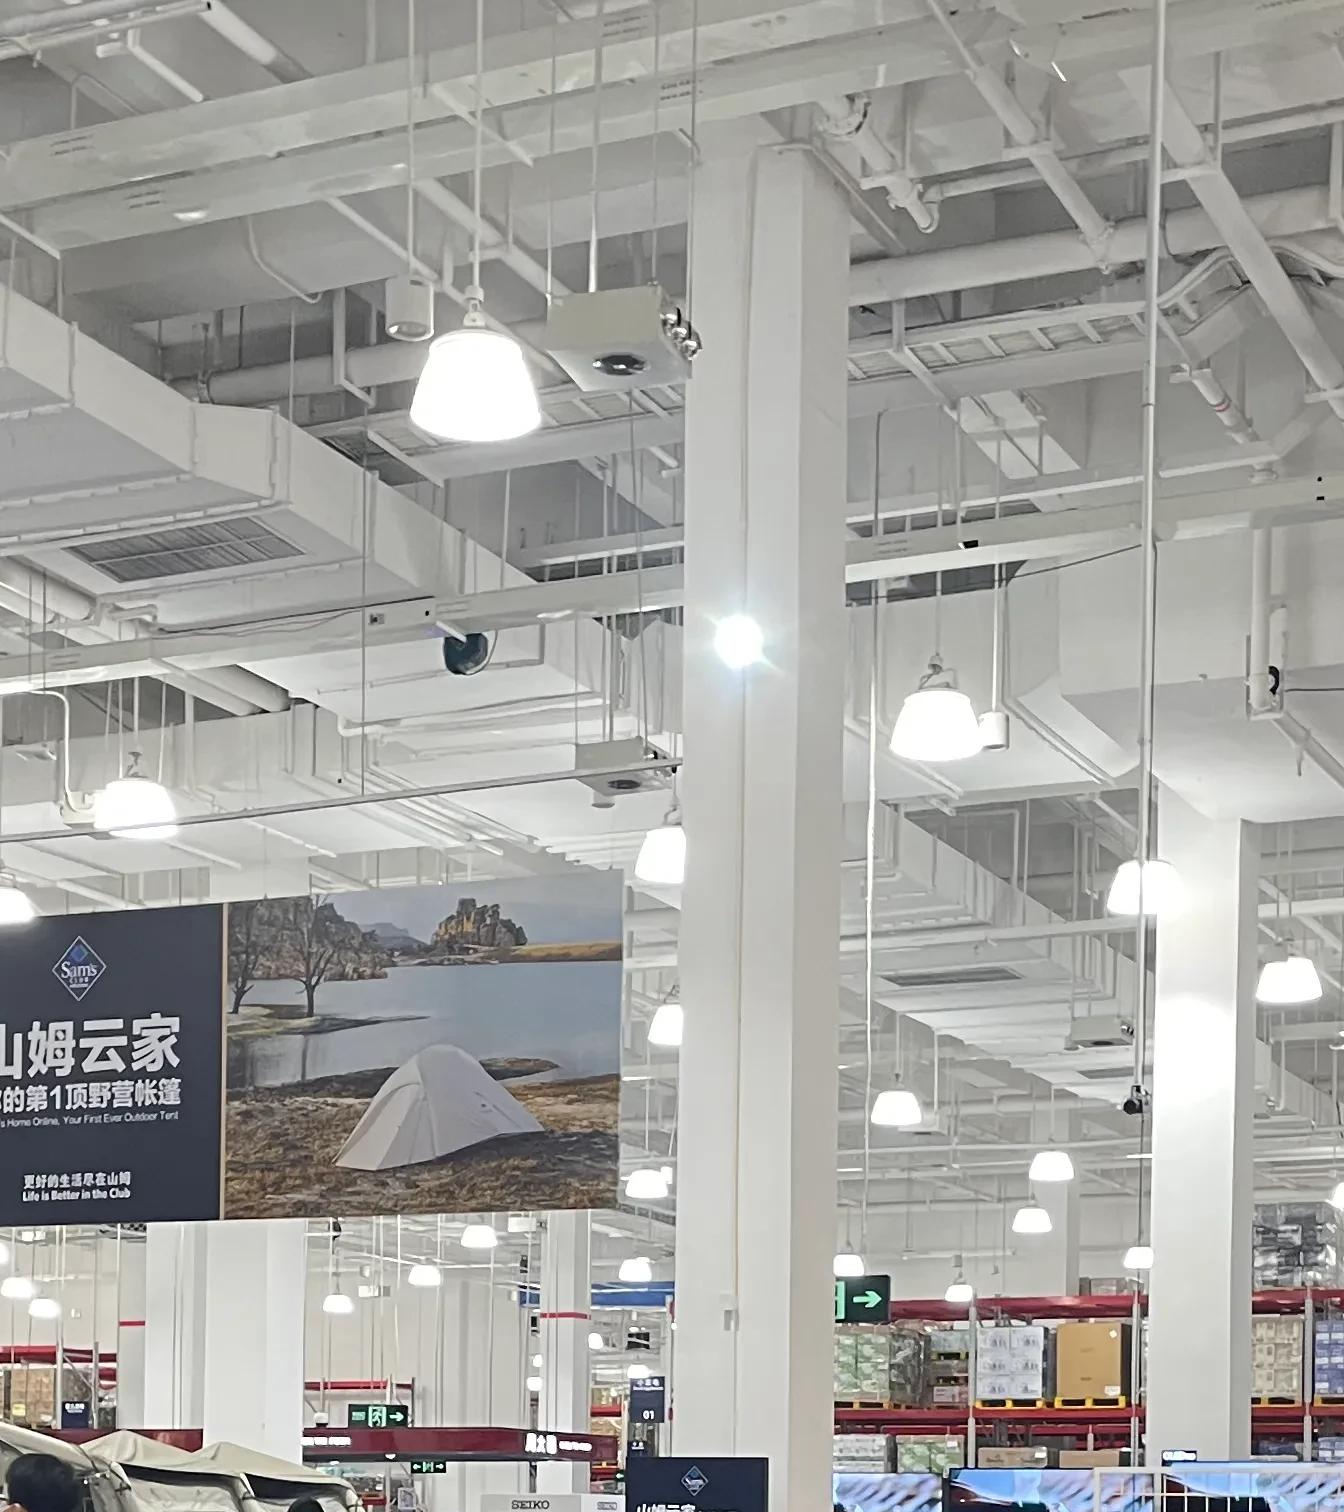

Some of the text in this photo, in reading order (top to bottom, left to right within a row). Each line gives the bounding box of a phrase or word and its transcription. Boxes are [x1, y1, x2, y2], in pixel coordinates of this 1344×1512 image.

[7, 1117, 31, 1128] Home
[63, 1115, 82, 1126] Your
[83, 1114, 102, 1124] First
[103, 1113, 122, 1123] Ever
[124, 1112, 157, 1122] Outdoor
[160, 1110, 179, 1121] Tent
[22, 1190, 40, 1202] Life
[51, 1189, 81, 1201] Better
[81, 1188, 91, 1200] in
[92, 1188, 108, 1199] the
[109, 1187, 131, 1199] Club
[642, 1410, 655, 1420] 01
[511, 1499, 550, 1510] SEIKO
